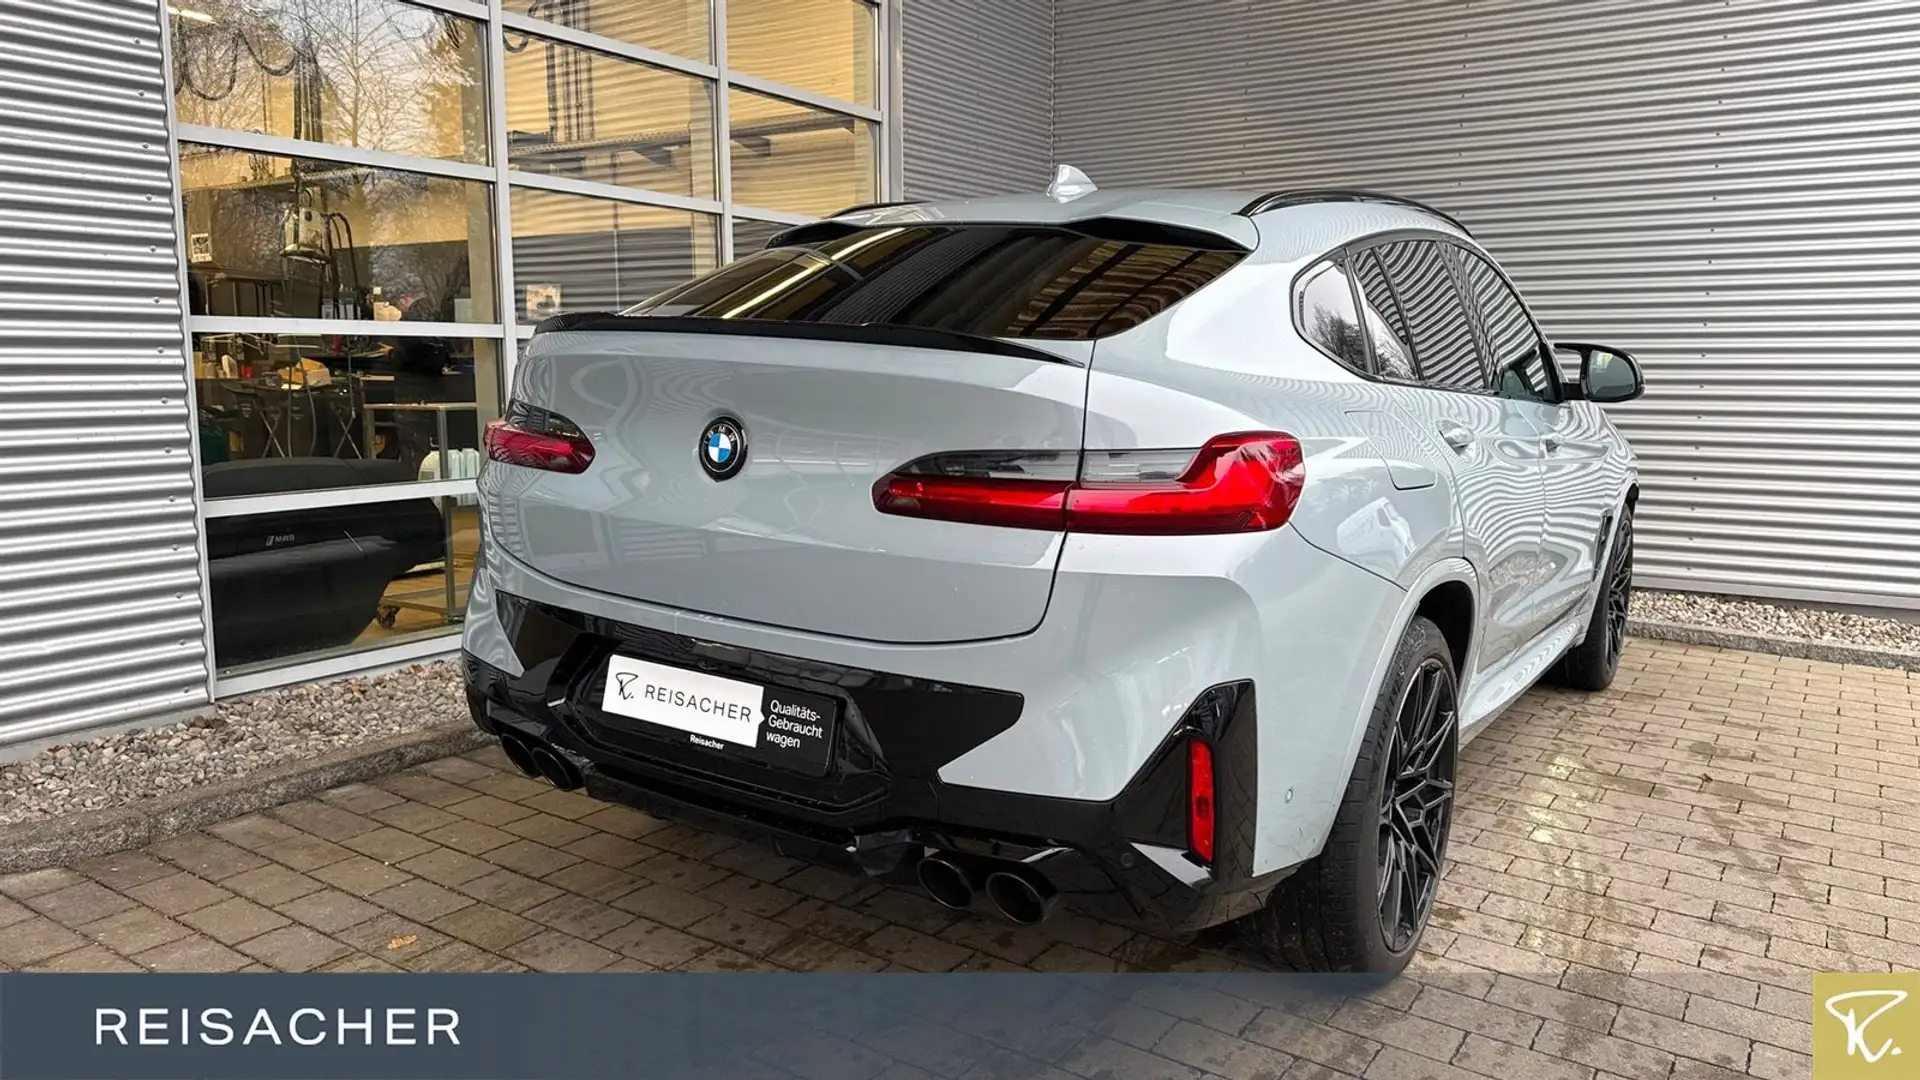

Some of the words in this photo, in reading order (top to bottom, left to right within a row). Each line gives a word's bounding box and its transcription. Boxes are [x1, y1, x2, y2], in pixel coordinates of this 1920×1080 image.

[644, 684, 752, 722] REISACHER
[770, 700, 821, 721] Qualitäts-
[768, 714, 823, 739] Gebraucht
[690, 734, 724, 750] Reisacher
[766, 731, 801, 748] wagen
